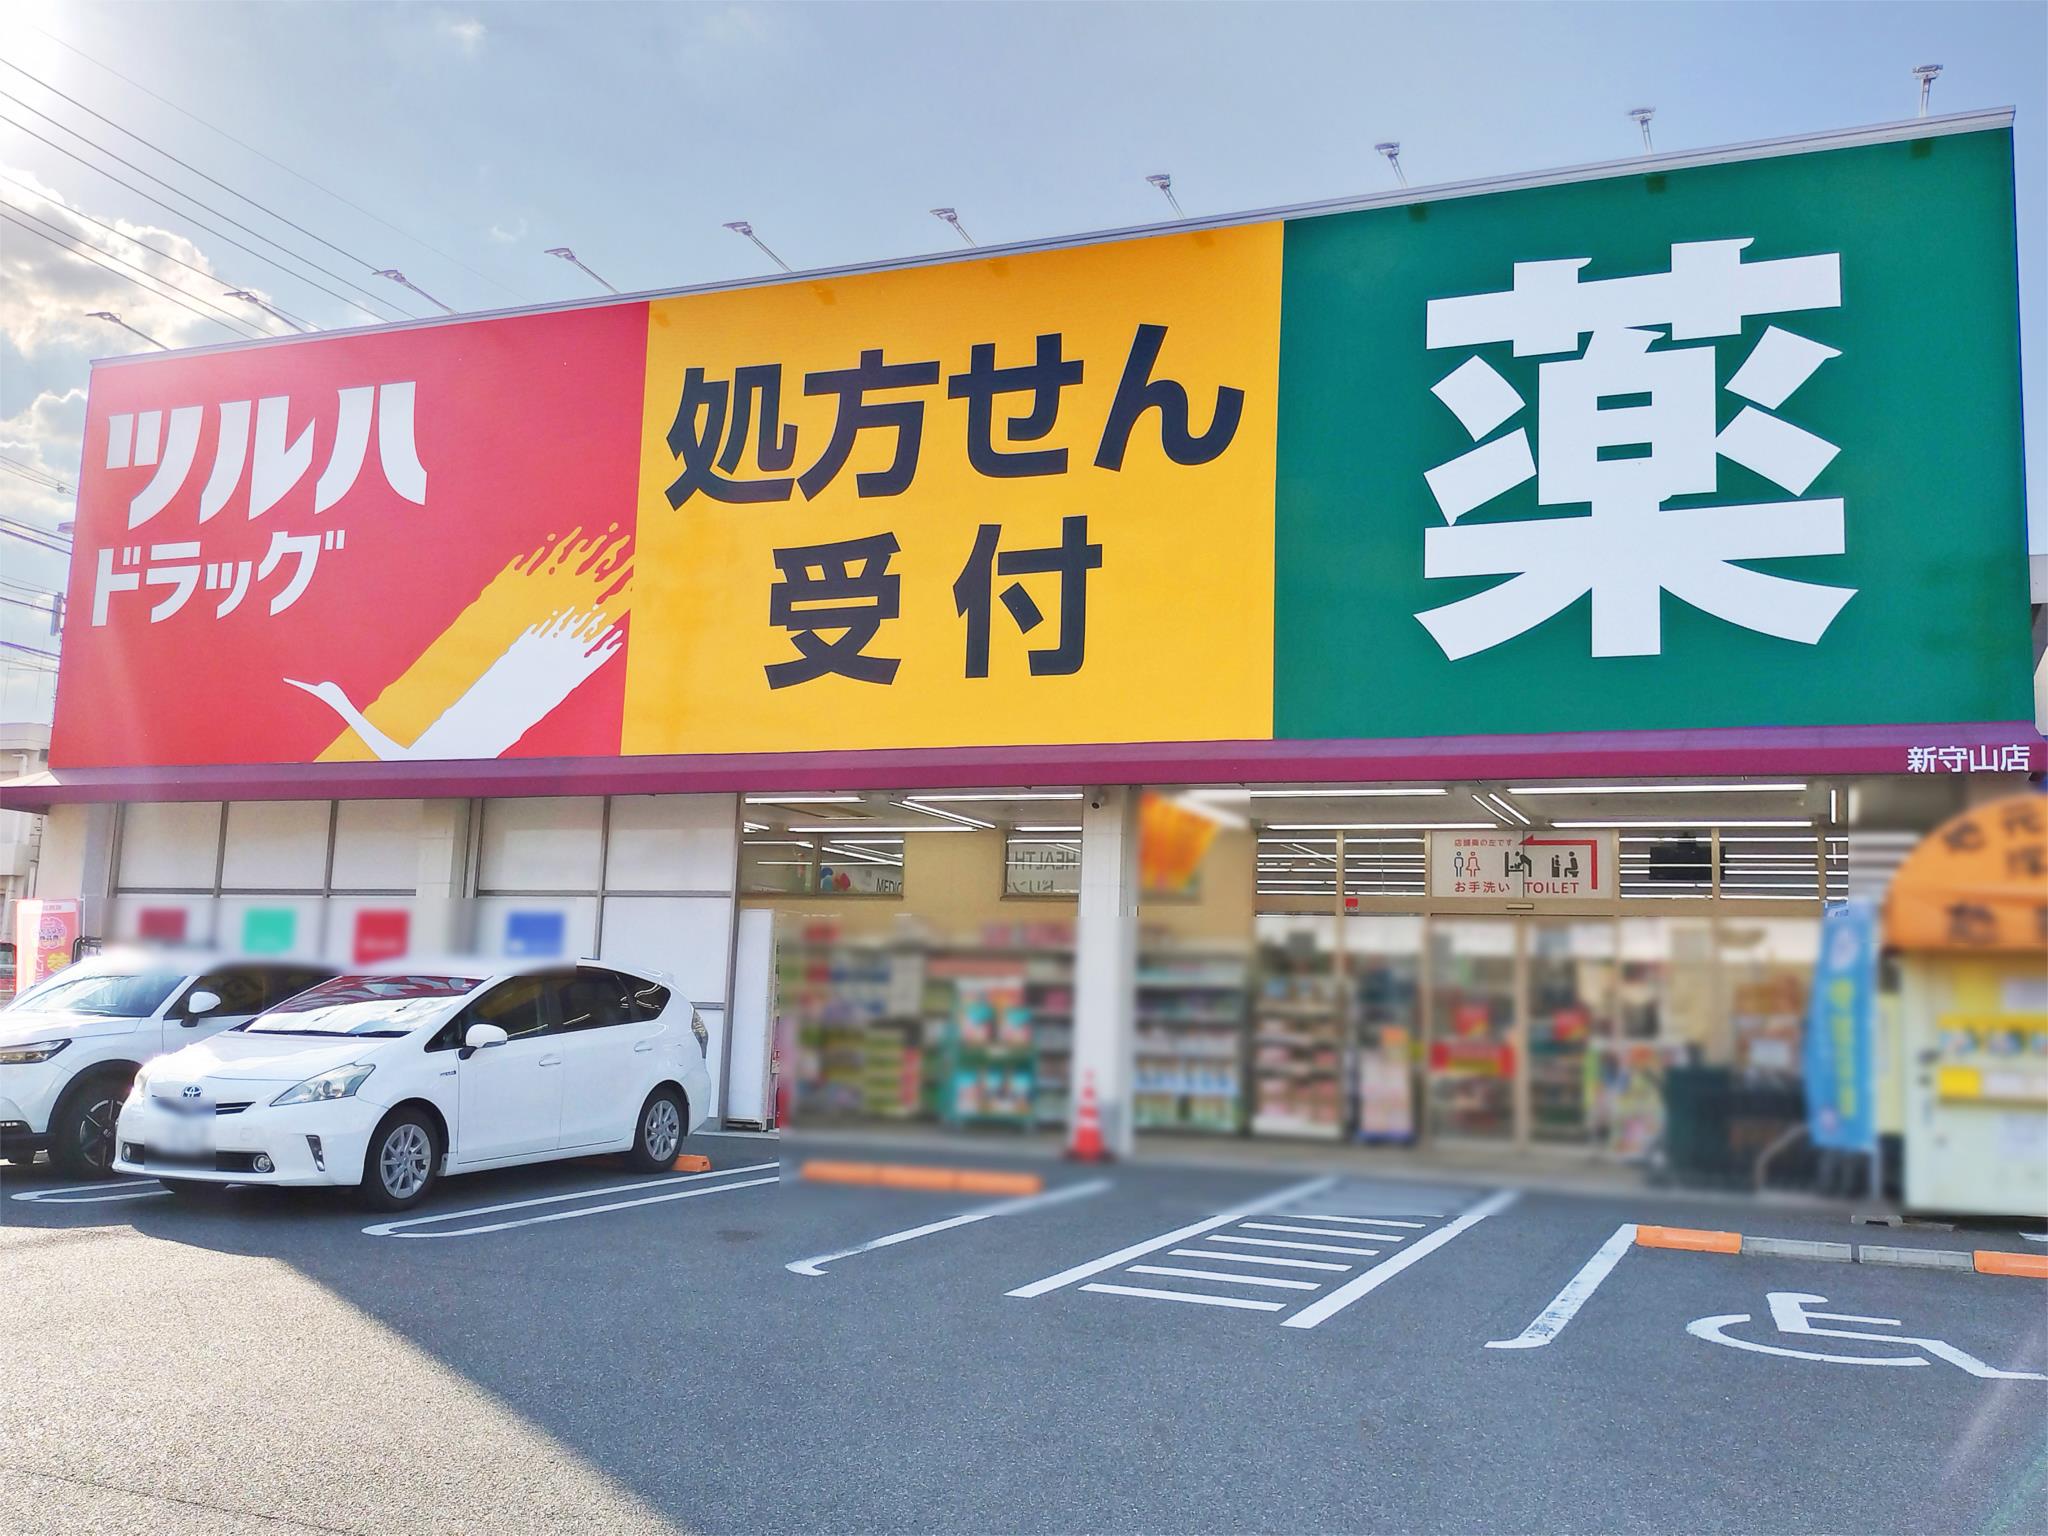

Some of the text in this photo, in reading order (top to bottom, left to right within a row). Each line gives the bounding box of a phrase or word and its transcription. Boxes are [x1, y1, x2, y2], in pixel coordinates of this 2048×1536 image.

[105, 381, 427, 531] ツルハ
[664, 323, 1245, 511] 処方せん
[1412, 237, 1859, 662] 薬
[91, 529, 346, 627] ドラッグ
[763, 515, 1103, 690] 受付
[1907, 744, 2031, 773] 新守山店
[1454, 881, 1580, 894] お手洗い TOILET
